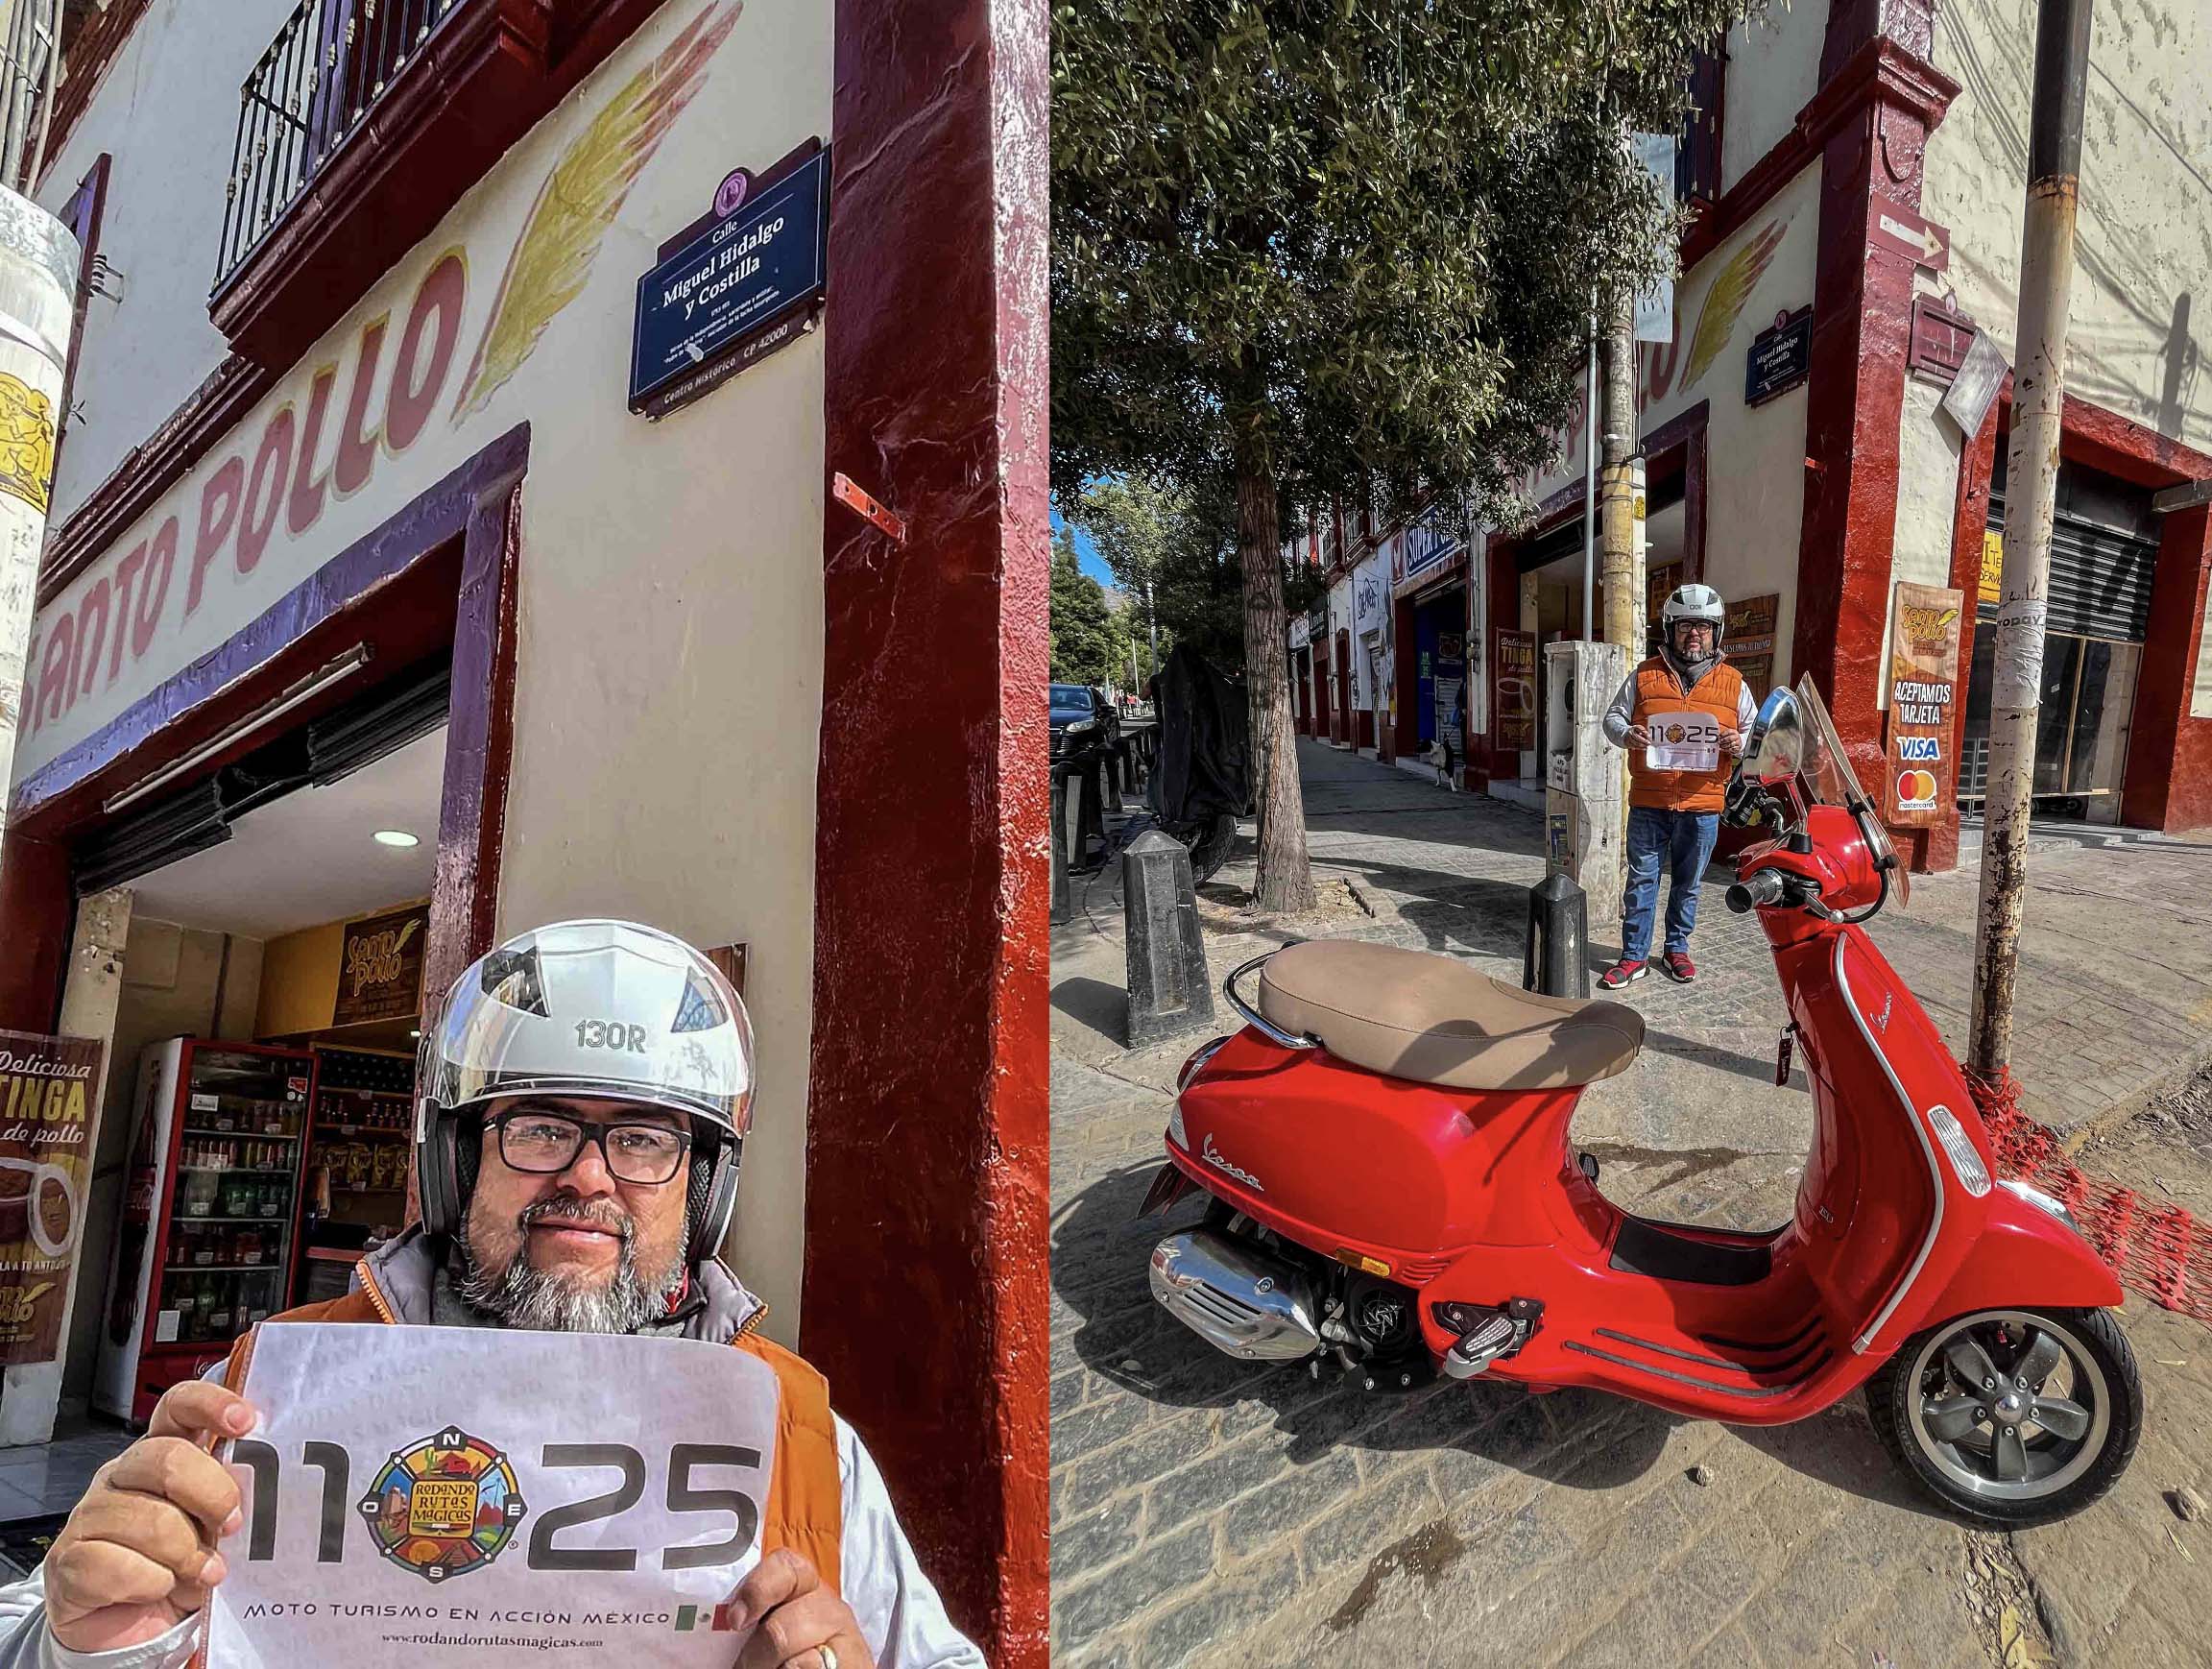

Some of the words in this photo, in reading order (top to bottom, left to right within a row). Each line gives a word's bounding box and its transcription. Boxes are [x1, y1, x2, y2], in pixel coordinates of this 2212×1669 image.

[712, 220, 737, 243] Calle
[662, 258, 715, 307] Miguel
[719, 217, 784, 270] Hidalgo
[685, 299, 695, 321] y
[698, 255, 760, 304] Costilla
[1756, 348, 1775, 365] Miguel
[1775, 337, 1798, 354] Hidalgo
[1768, 351, 1791, 368] Costilla
[663, 381, 693, 404] Centro
[695, 357, 736, 387] Histórico
[757, 324, 788, 350] 42000
[182, 244, 469, 626] POLLO
[1501, 645, 1533, 665] TINGA
[1894, 681, 1951, 703] ACEPTAMOS
[1900, 703, 1940, 724] TARJETA
[1649, 725, 1664, 742] 11
[1687, 725, 1719, 743] 25
[1900, 738, 1939, 759] VISA
[574, 1019, 646, 1053] 130R
[0, 1050, 92, 1078] Deliciosa
[0, 1122, 30, 1142] de
[30, 1124, 85, 1149] pollo
[1201, 1132, 1264, 1192] Vespa
[443, 1433, 461, 1446] N
[231, 1439, 349, 1563] 11
[527, 1442, 761, 1572] 25
[507, 1503, 522, 1516] E
[429, 1566, 444, 1579] S
[244, 1603, 317, 1619] MOTO
[329, 1604, 438, 1619] TURISMO
[449, 1608, 479, 1622] EN
[490, 1609, 571, 1625] ACCIÓN
[582, 1610, 669, 1625] MÉXICO
[382, 1632, 604, 1651] www.rodandorutasmagicas.com
